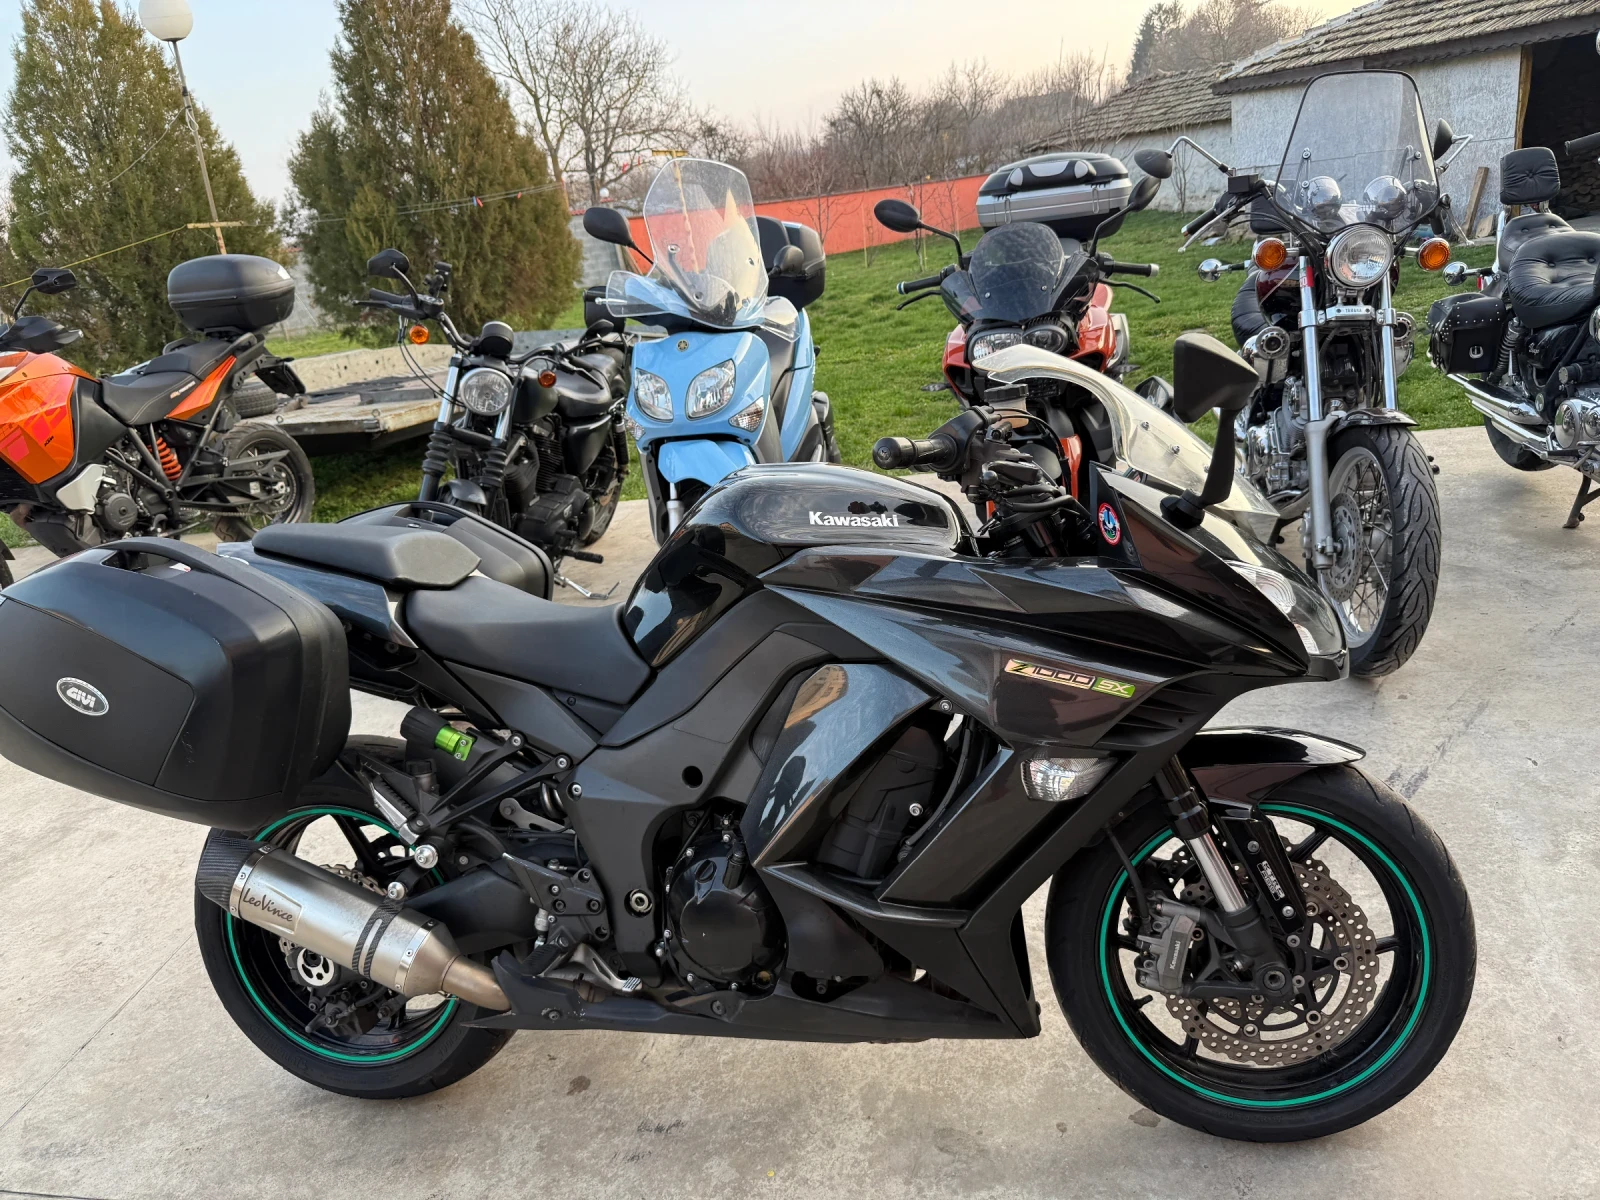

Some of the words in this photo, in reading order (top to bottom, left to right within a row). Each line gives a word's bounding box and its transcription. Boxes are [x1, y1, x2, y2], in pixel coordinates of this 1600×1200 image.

[808, 511, 900, 527] Kawasaki
[1010, 662, 1094, 685] Z1000
[1097, 679, 1131, 694] SX
[66, 687, 96, 708] GIVI
[242, 887, 294, 922] LeoVince
[1169, 940, 1182, 970] Kawasaki
